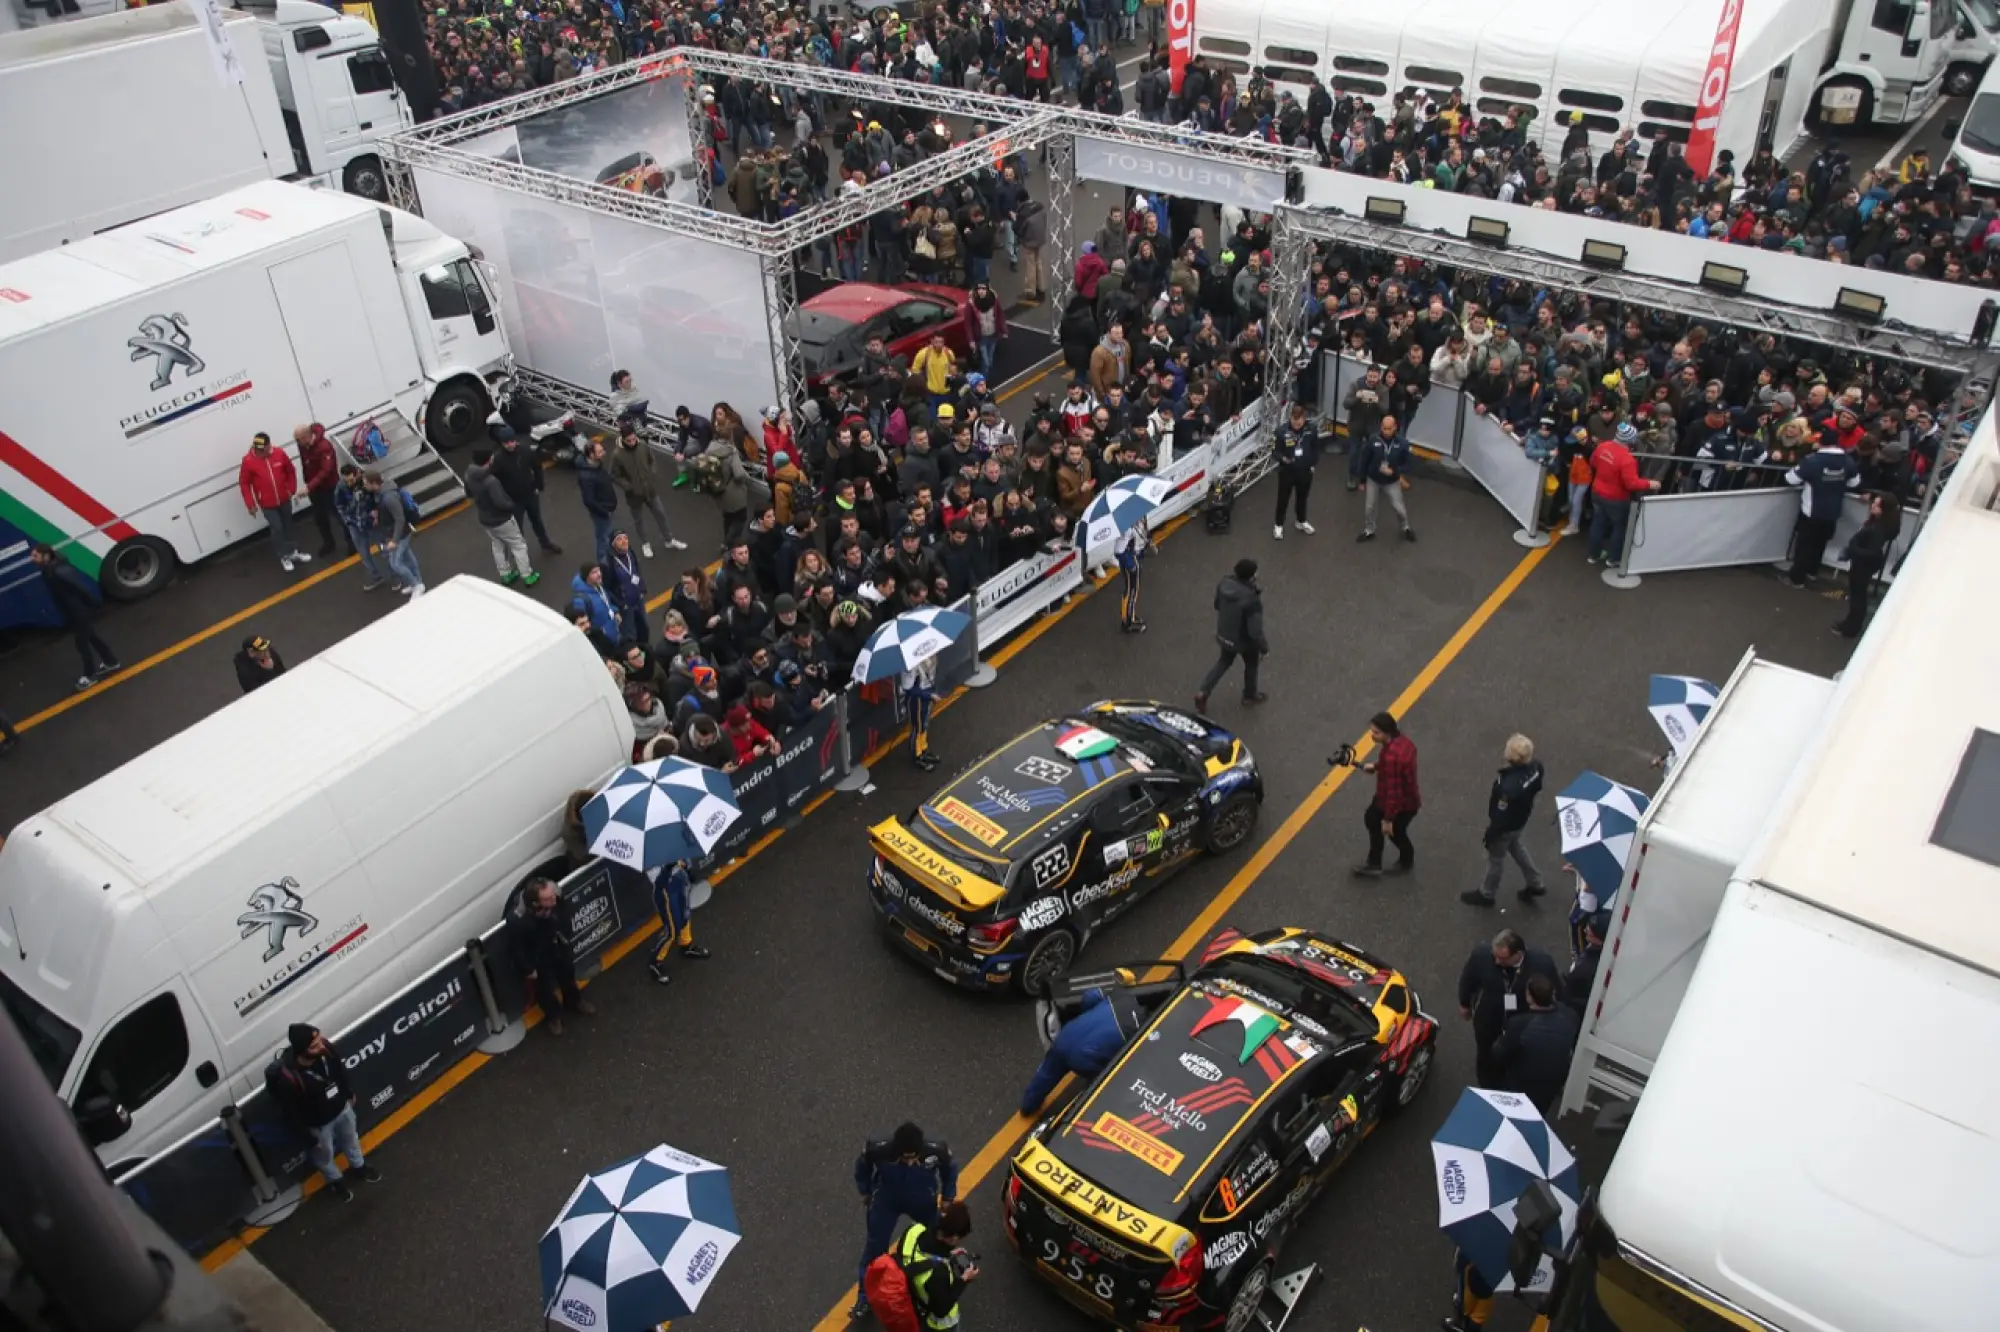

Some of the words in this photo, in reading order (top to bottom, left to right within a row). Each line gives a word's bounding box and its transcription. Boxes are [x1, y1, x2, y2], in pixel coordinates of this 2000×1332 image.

[120, 386, 207, 428] PEUGEOT
[210, 369, 248, 392] SPORT
[221, 393, 252, 411] ITALIA
[977, 561, 1043, 607] EUGEOT
[733, 765, 773, 798] andro
[776, 736, 814, 769] Bosca
[1018, 757, 1070, 783] 222
[977, 776, 1005, 793] Fred
[1000, 789, 1031, 812] Mello
[941, 800, 1001, 843] PIRELLI
[881, 832, 961, 886] SANTERO
[1033, 845, 1069, 888] 222
[233, 942, 321, 1009] PEUGEOT
[325, 912, 363, 944] SPORT
[336, 935, 367, 961] ITALIA
[392, 977, 462, 1035] Cairoli
[1130, 1079, 1167, 1105] Fred
[1163, 1098, 1207, 1131] Mello
[1140, 1100, 1160, 1116] New
[1161, 1111, 1181, 1130] York
[1101, 1117, 1175, 1168] PIRELLI
[1036, 1160, 1148, 1235] SANTERO
[1219, 1178, 1237, 1212] 6
[686, 1241, 716, 1282] MAGNETI
[688, 1243, 718, 1286] MARELLI
[1204, 1237, 1247, 1268] MARELLI
